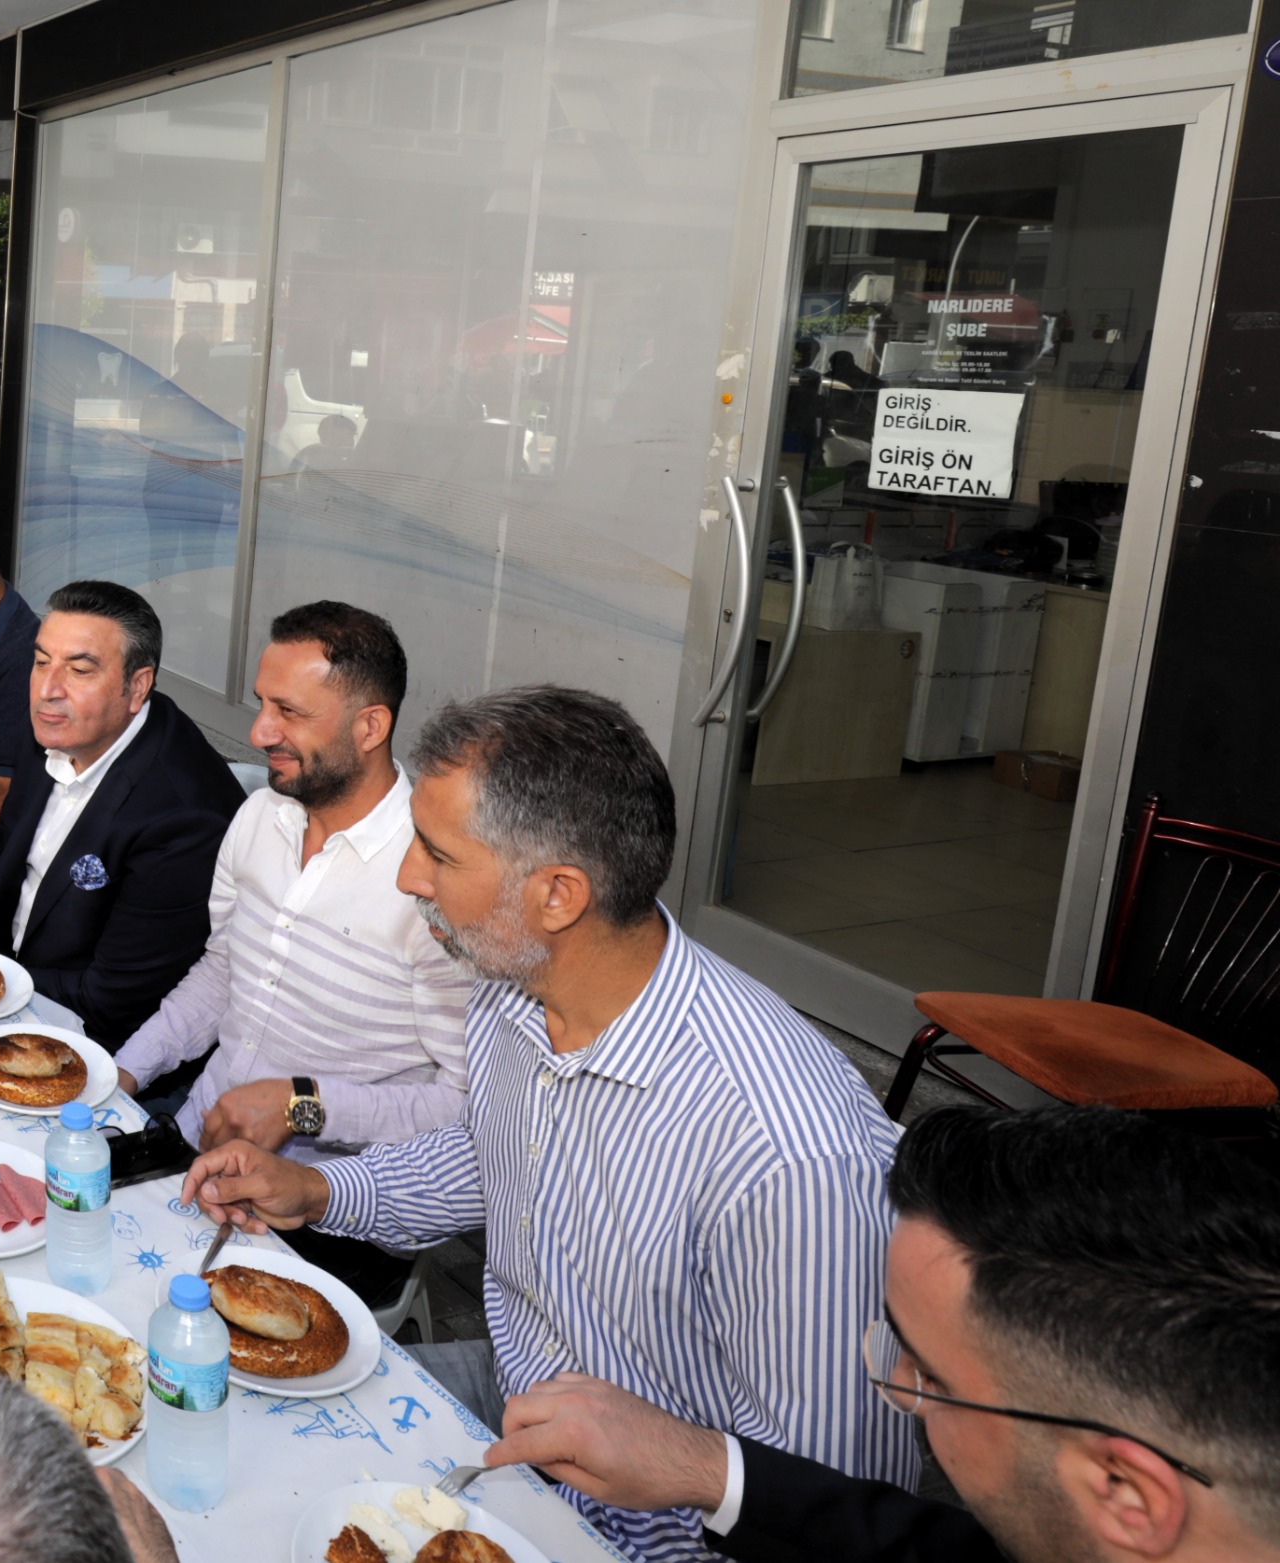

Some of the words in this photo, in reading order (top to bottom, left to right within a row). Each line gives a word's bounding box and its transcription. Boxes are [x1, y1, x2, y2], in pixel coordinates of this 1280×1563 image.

[927, 298, 1014, 314] NARLIDERE
[946, 323, 988, 341] ŞUBE
[885, 393, 932, 413] GİRİŞ
[882, 412, 972, 433] DEĞİLDİR.
[878, 446, 935, 471] GİRİŞ
[941, 449, 973, 471] ÖN
[876, 471, 996, 497] TARAFTAN.
